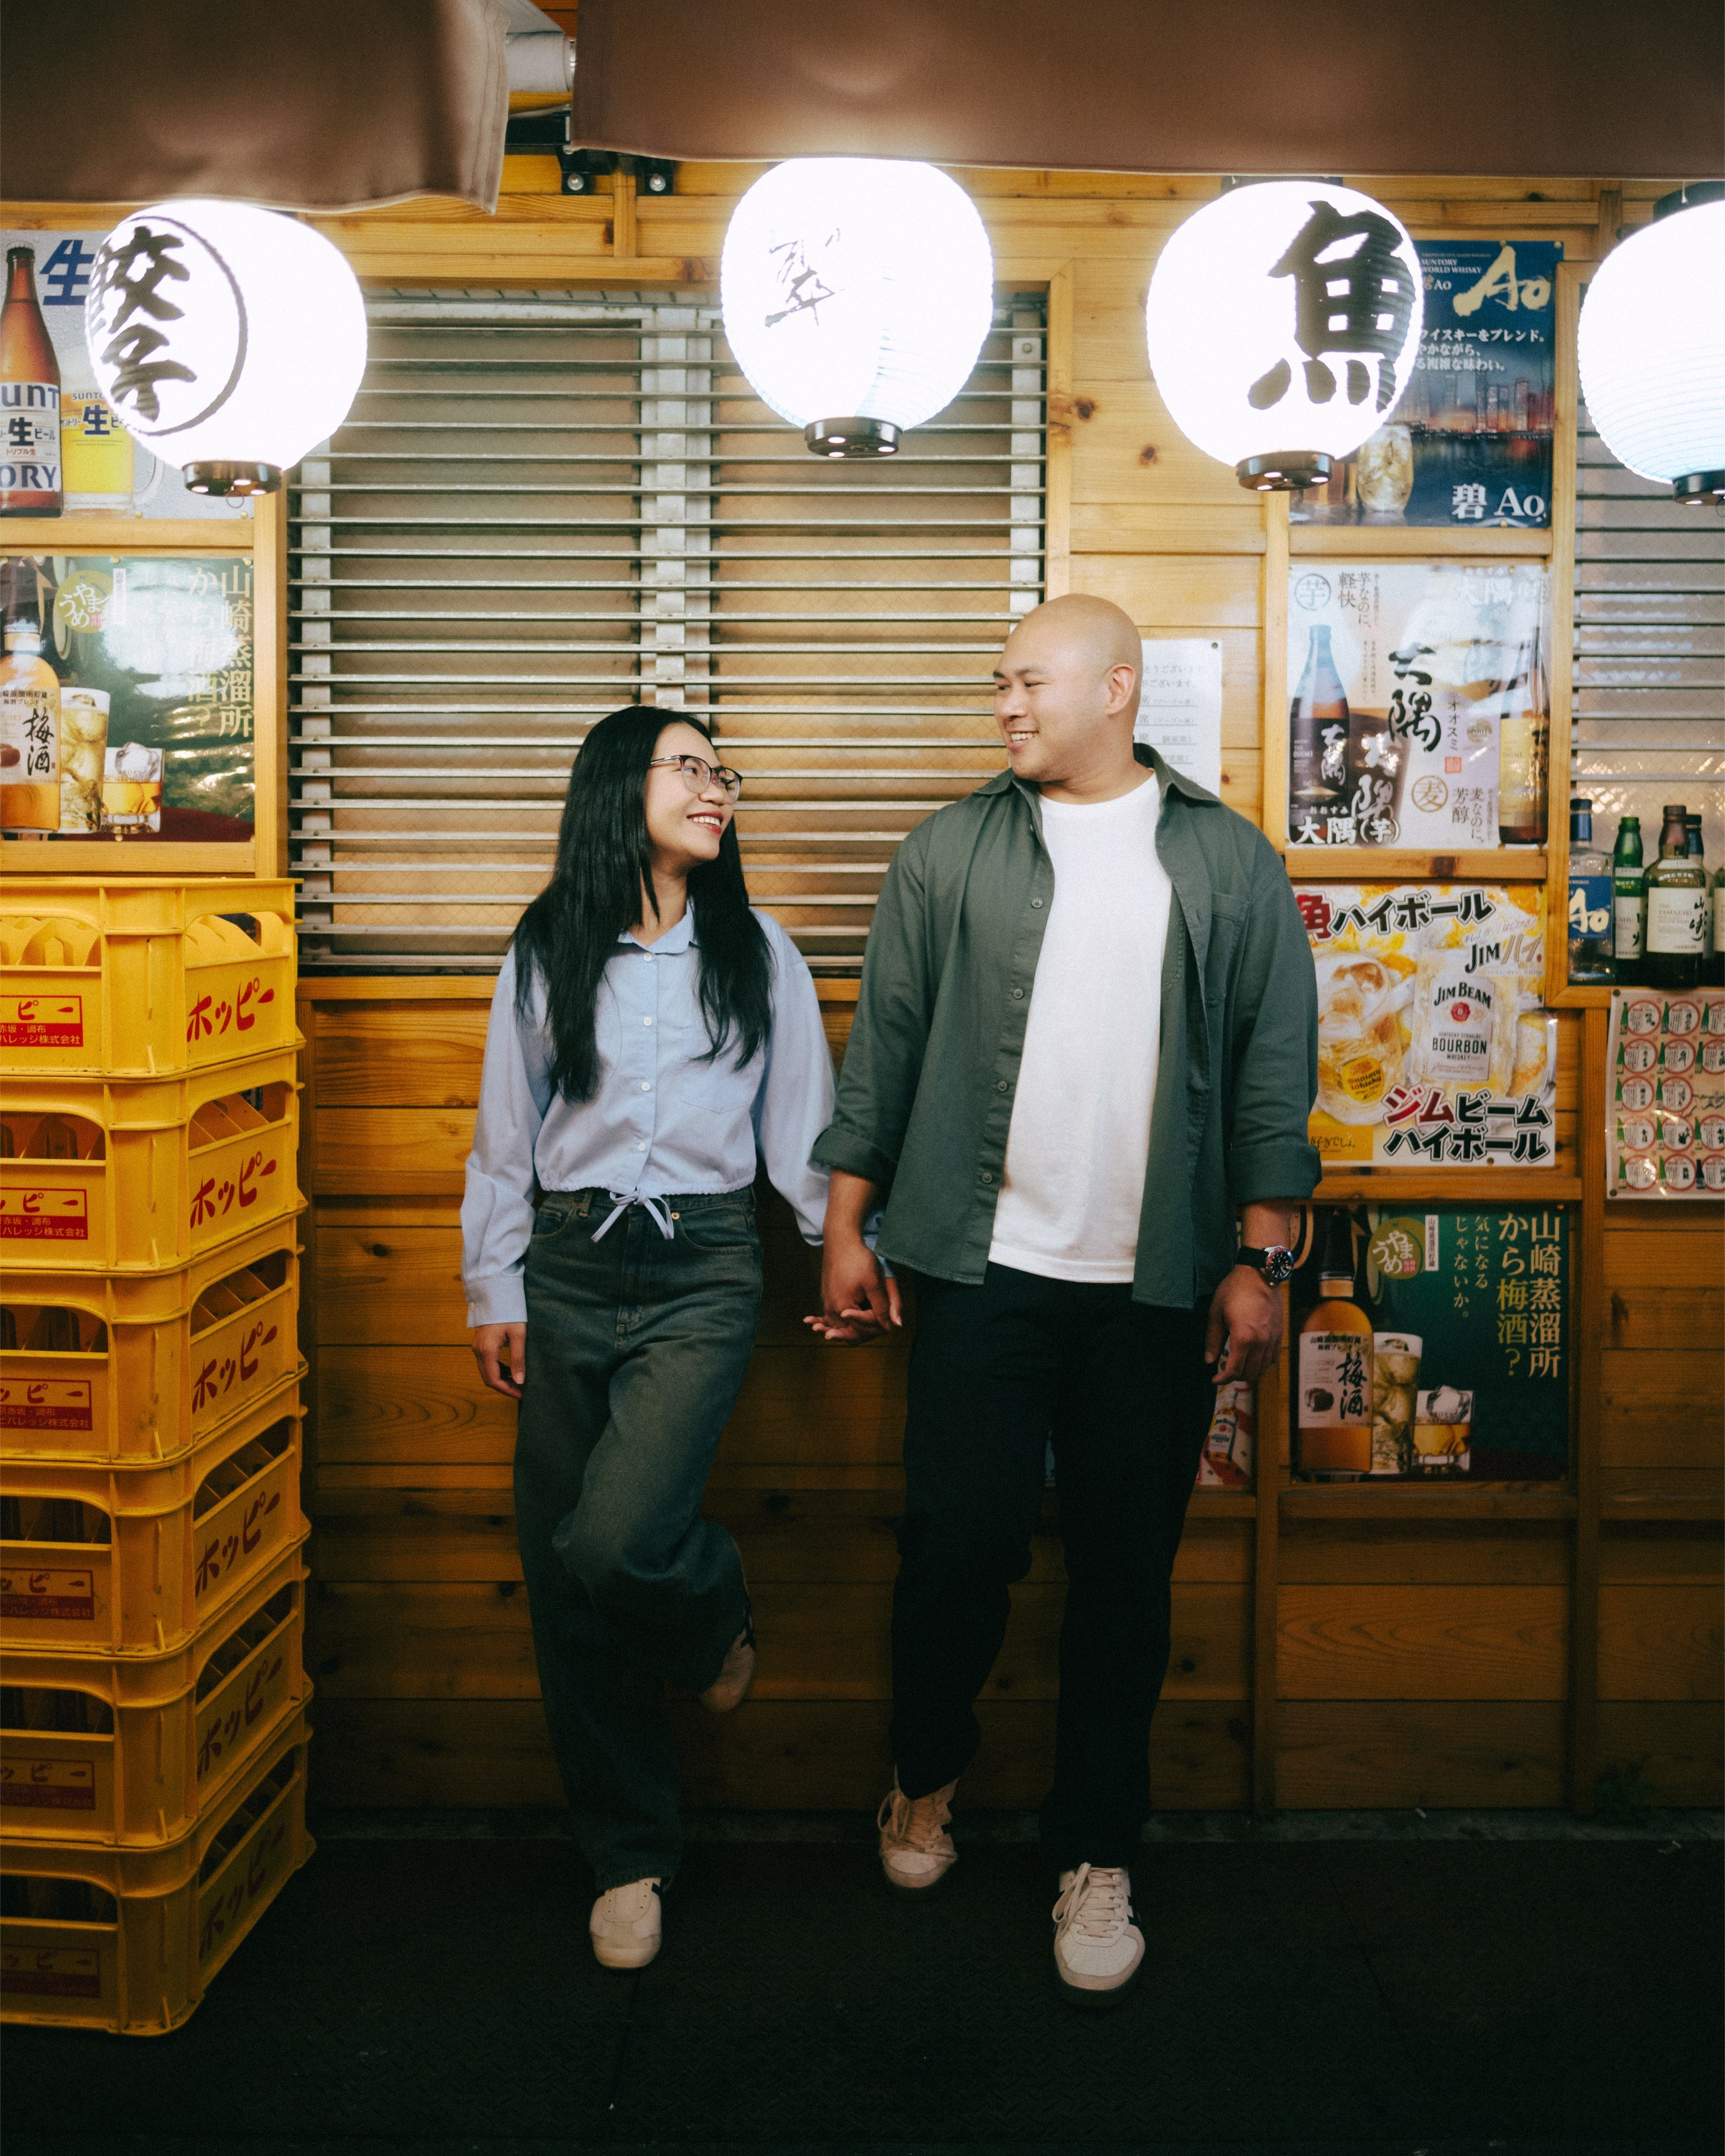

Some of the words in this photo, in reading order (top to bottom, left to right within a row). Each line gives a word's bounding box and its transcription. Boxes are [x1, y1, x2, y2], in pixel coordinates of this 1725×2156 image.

[40, 239, 95, 306] 生
[1247, 199, 1417, 414] 魚
[1453, 245, 1551, 317] Ao
[1494, 487, 1545, 518] Ao
[1338, 571, 1357, 609] 軽快
[23, 706, 55, 776] 梅酒
[1451, 788, 1469, 824] 芳醇
[186, 976, 276, 1043] ホッピー
[1434, 986, 1456, 1007] JIM
[1458, 982, 1492, 1009] BEAM
[1432, 1038, 1487, 1054] BOURBON
[1384, 1085, 1550, 1128] ジムビーム
[1386, 1124, 1548, 1161] ハイボール
[0, 1217, 51, 1226] 赤坂・調布
[190, 1151, 277, 1230] ホッピー
[1453, 1216, 1470, 1318] じゃないか。
[1475, 1215, 1490, 1289] 気になる
[1496, 1212, 1529, 1376] から梅酒？
[1529, 1211, 1561, 1378] 山崎蒸溜所
[192, 1319, 278, 1415] ホッピー
[1336, 1351, 1368, 1419] 梅酒
[195, 1491, 281, 1598] ホッピー
[197, 1656, 283, 1782] ホッピー
